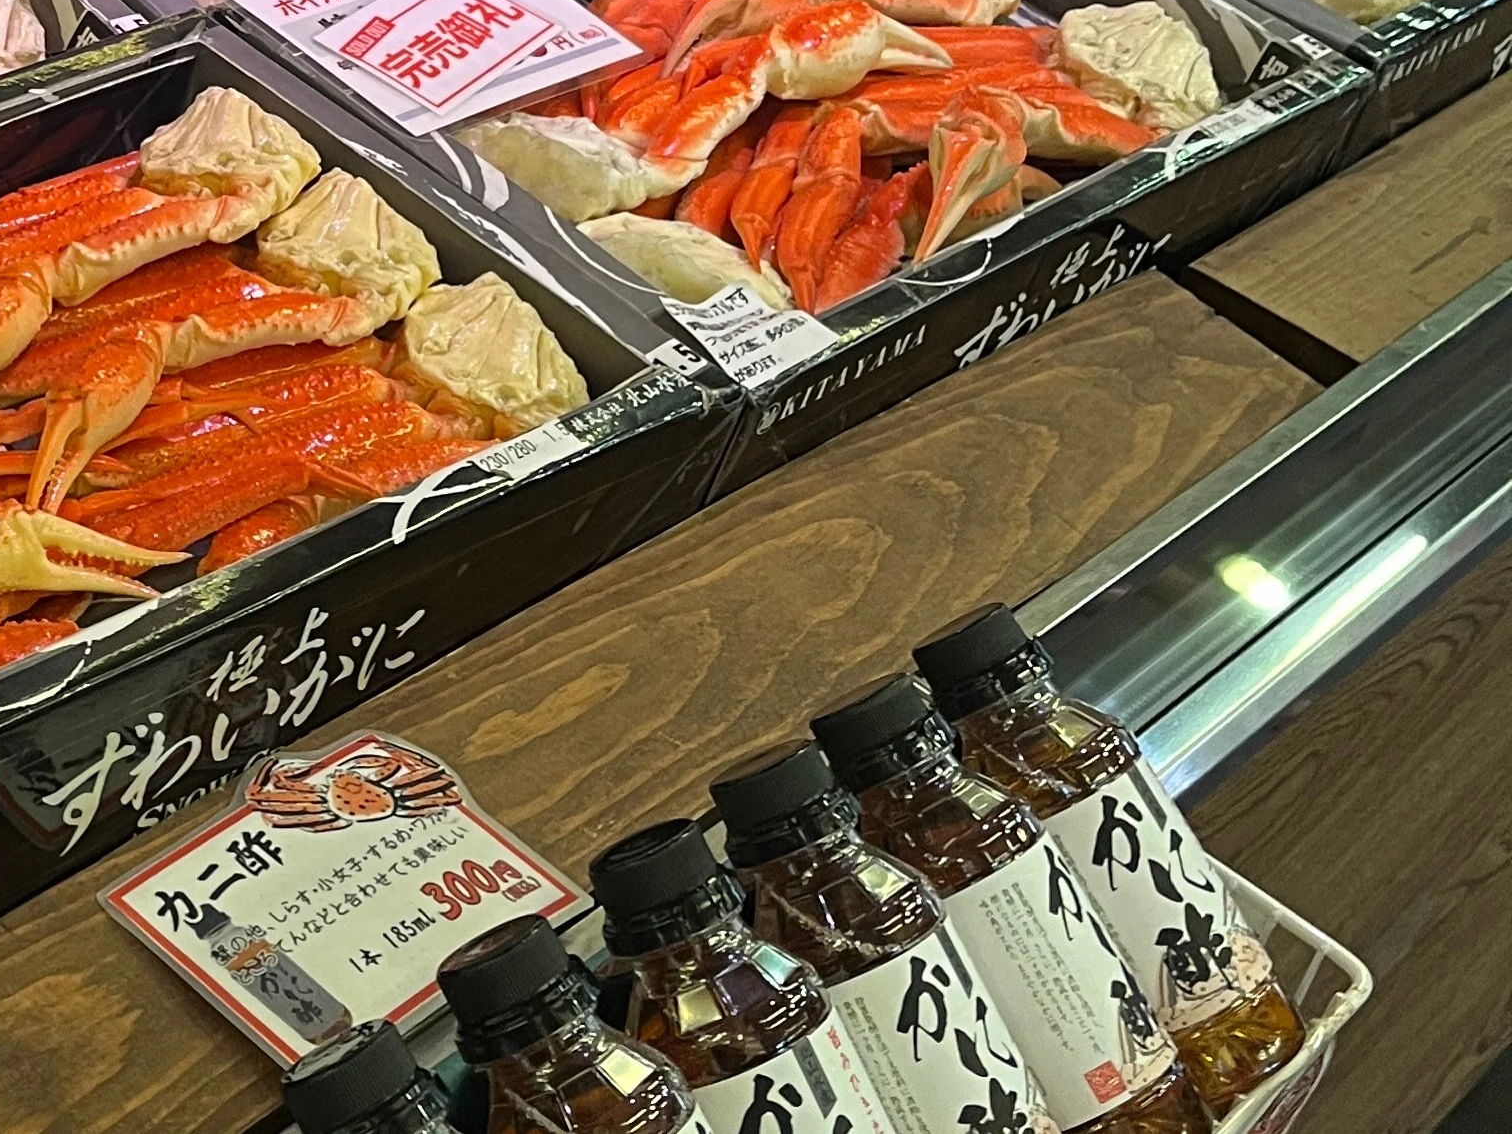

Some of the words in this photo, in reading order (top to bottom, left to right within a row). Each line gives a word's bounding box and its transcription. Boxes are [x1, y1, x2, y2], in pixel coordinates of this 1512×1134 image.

[778, 323, 928, 422] KITAYAMA
[478, 438, 538, 474] 230/280
[206, 607, 330, 702] 極上
[41, 608, 426, 858] ずわいがに
[155, 829, 286, 934] カニ酢
[1091, 794, 1238, 997] かに酢
[348, 948, 383, 973] 1本
[382, 907, 438, 949] 185ml
